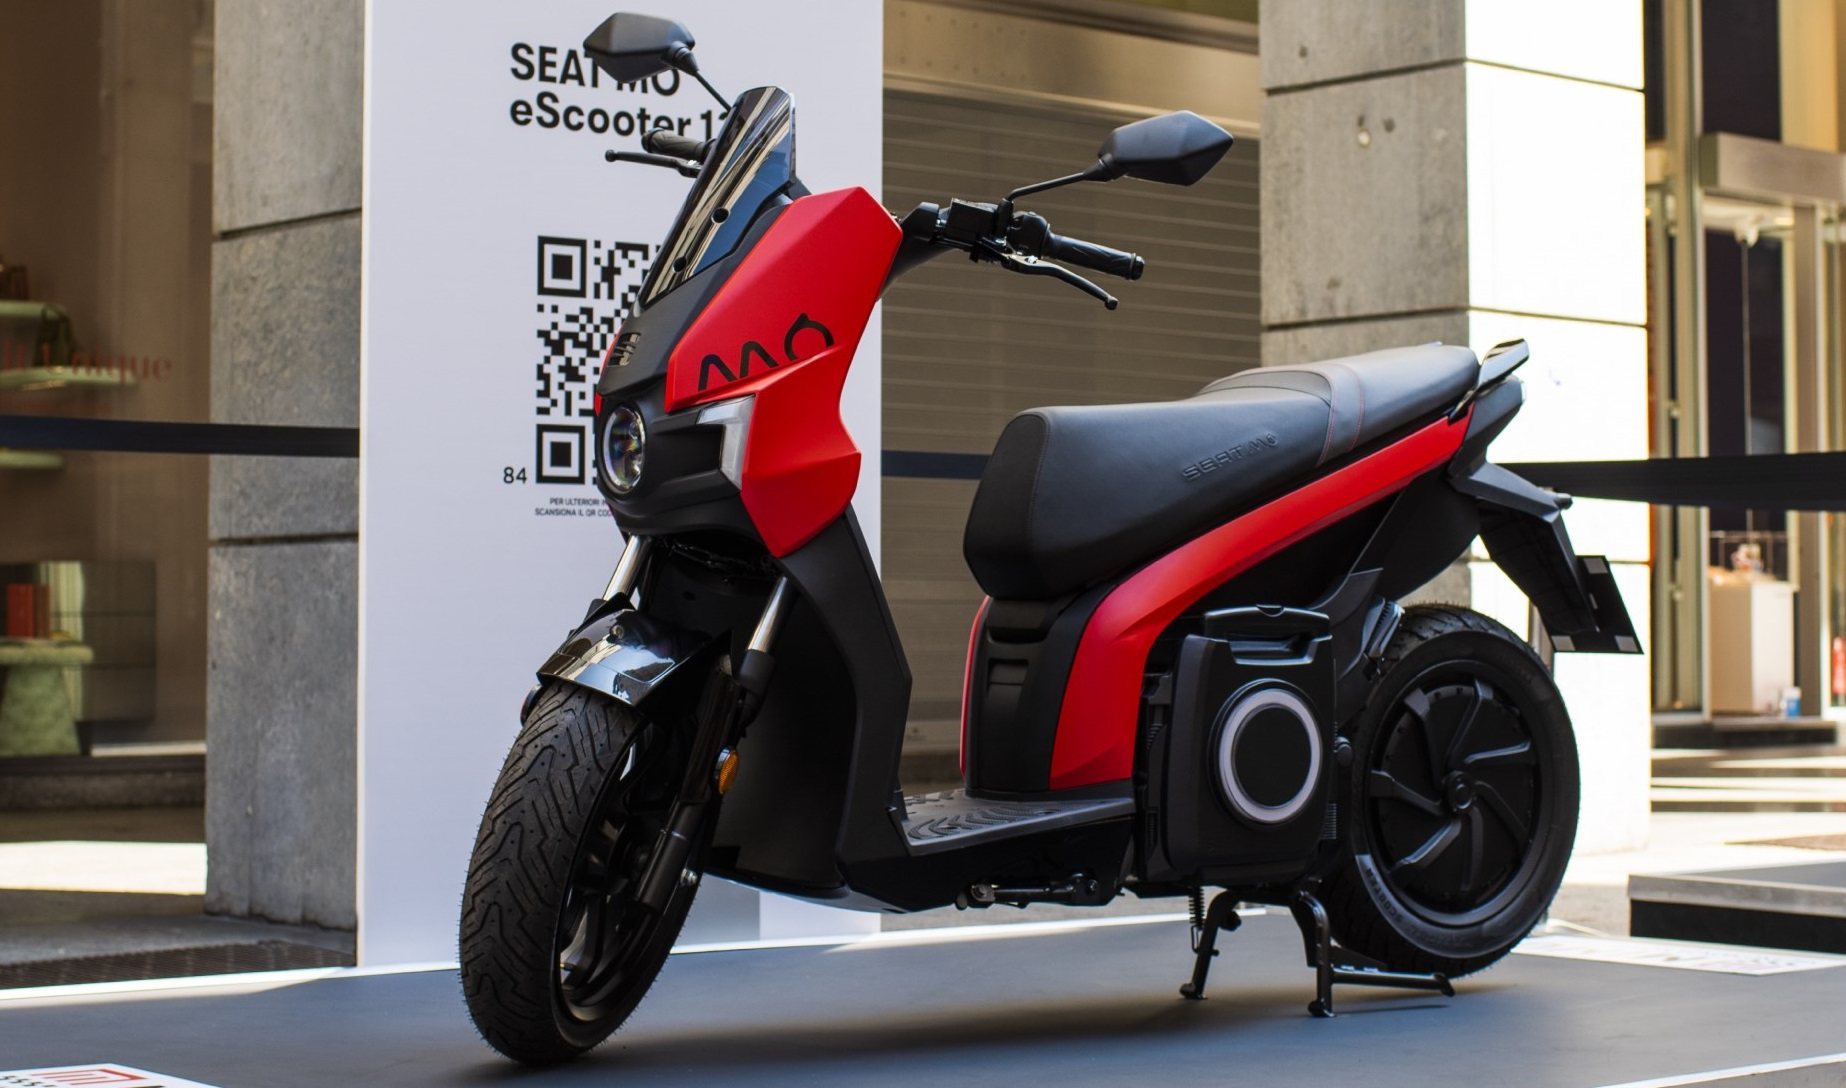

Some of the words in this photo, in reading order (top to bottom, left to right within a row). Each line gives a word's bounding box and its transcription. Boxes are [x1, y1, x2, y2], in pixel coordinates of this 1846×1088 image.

[511, 42, 599, 89] SEAT
[616, 66, 681, 97] O
[510, 91, 692, 137] eScooter
[700, 109, 729, 142] 1
[503, 466, 527, 484] 84
[1181, 445, 1243, 481] SEAT
[535, 507, 577, 517] SCANSIONA
[586, 508, 597, 518] QR
[549, 497, 564, 506] PER
[565, 498, 600, 507] ULTERIORI
